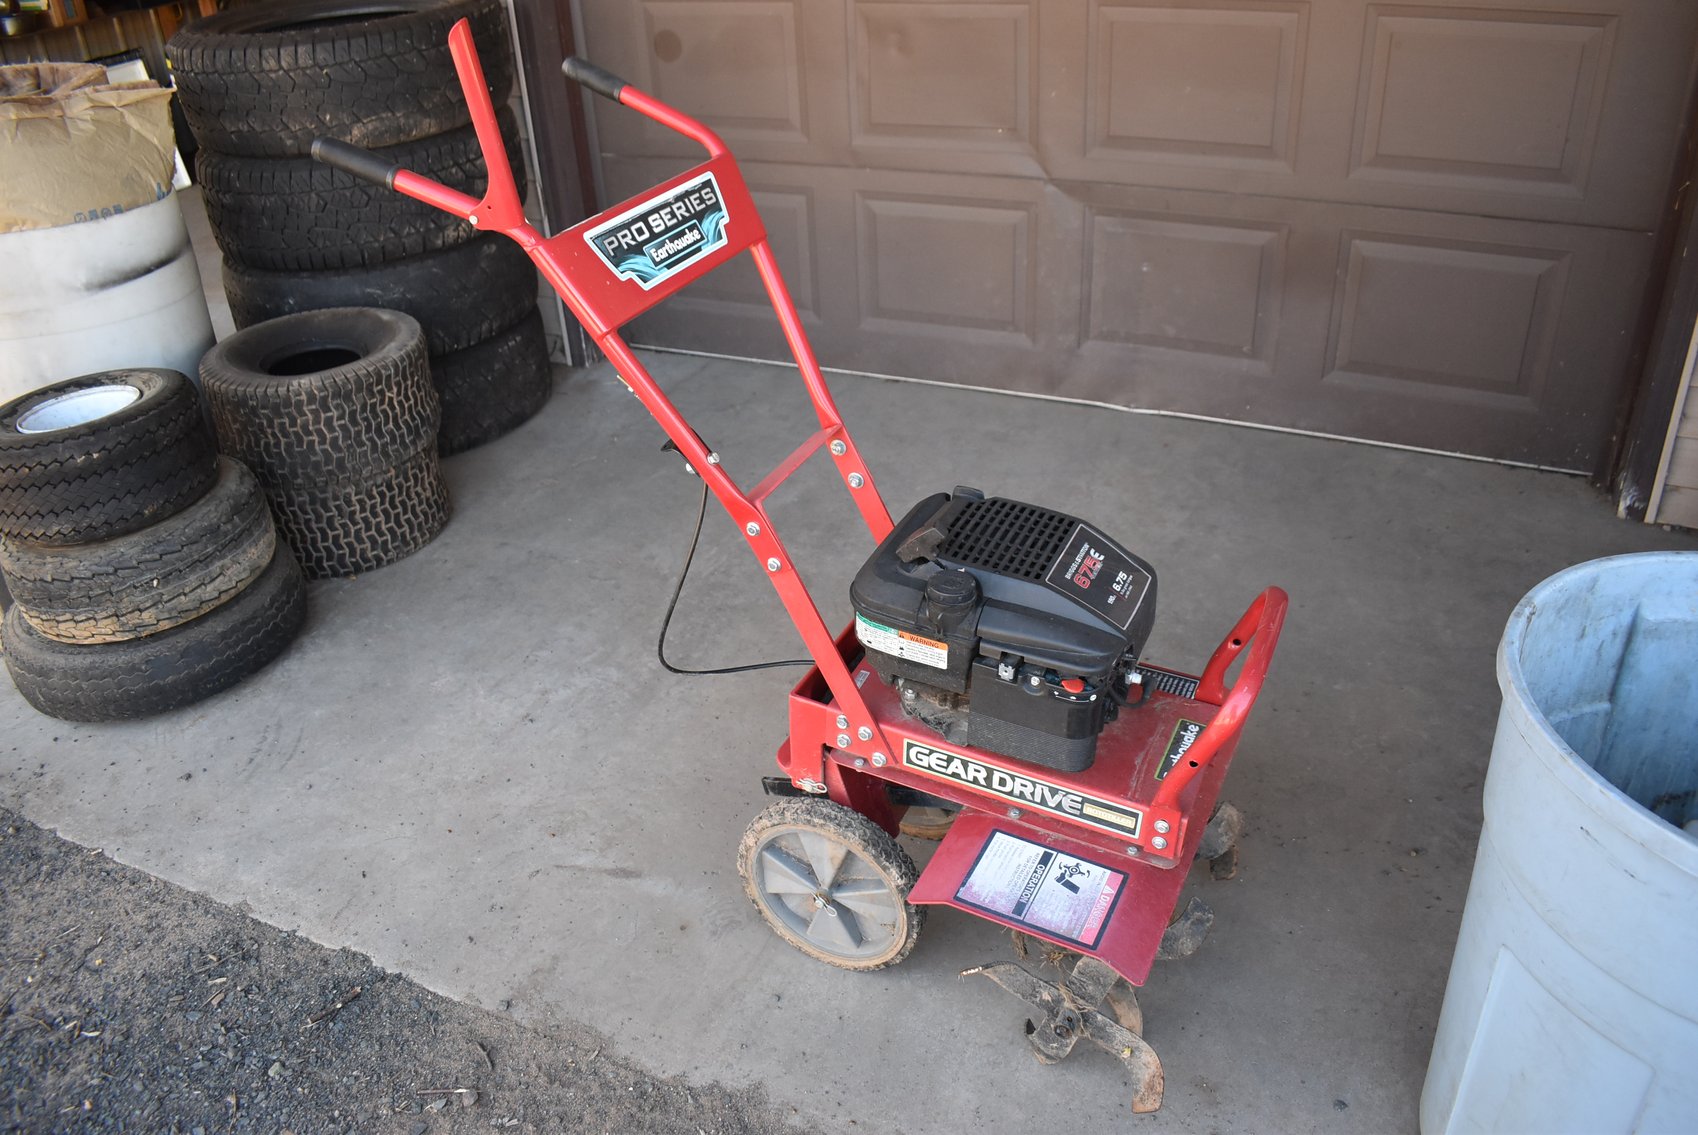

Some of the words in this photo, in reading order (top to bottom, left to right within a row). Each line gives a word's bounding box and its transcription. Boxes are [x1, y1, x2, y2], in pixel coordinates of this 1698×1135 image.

[603, 222, 650, 256] PRO
[647, 187, 717, 234] SERIES
[1112, 571, 1128, 592] 6.75
[909, 634, 940, 649] WARNING
[909, 746, 988, 786] GEAR
[991, 769, 1084, 815] DRIVE
[1018, 863, 1045, 904] OPERATION
